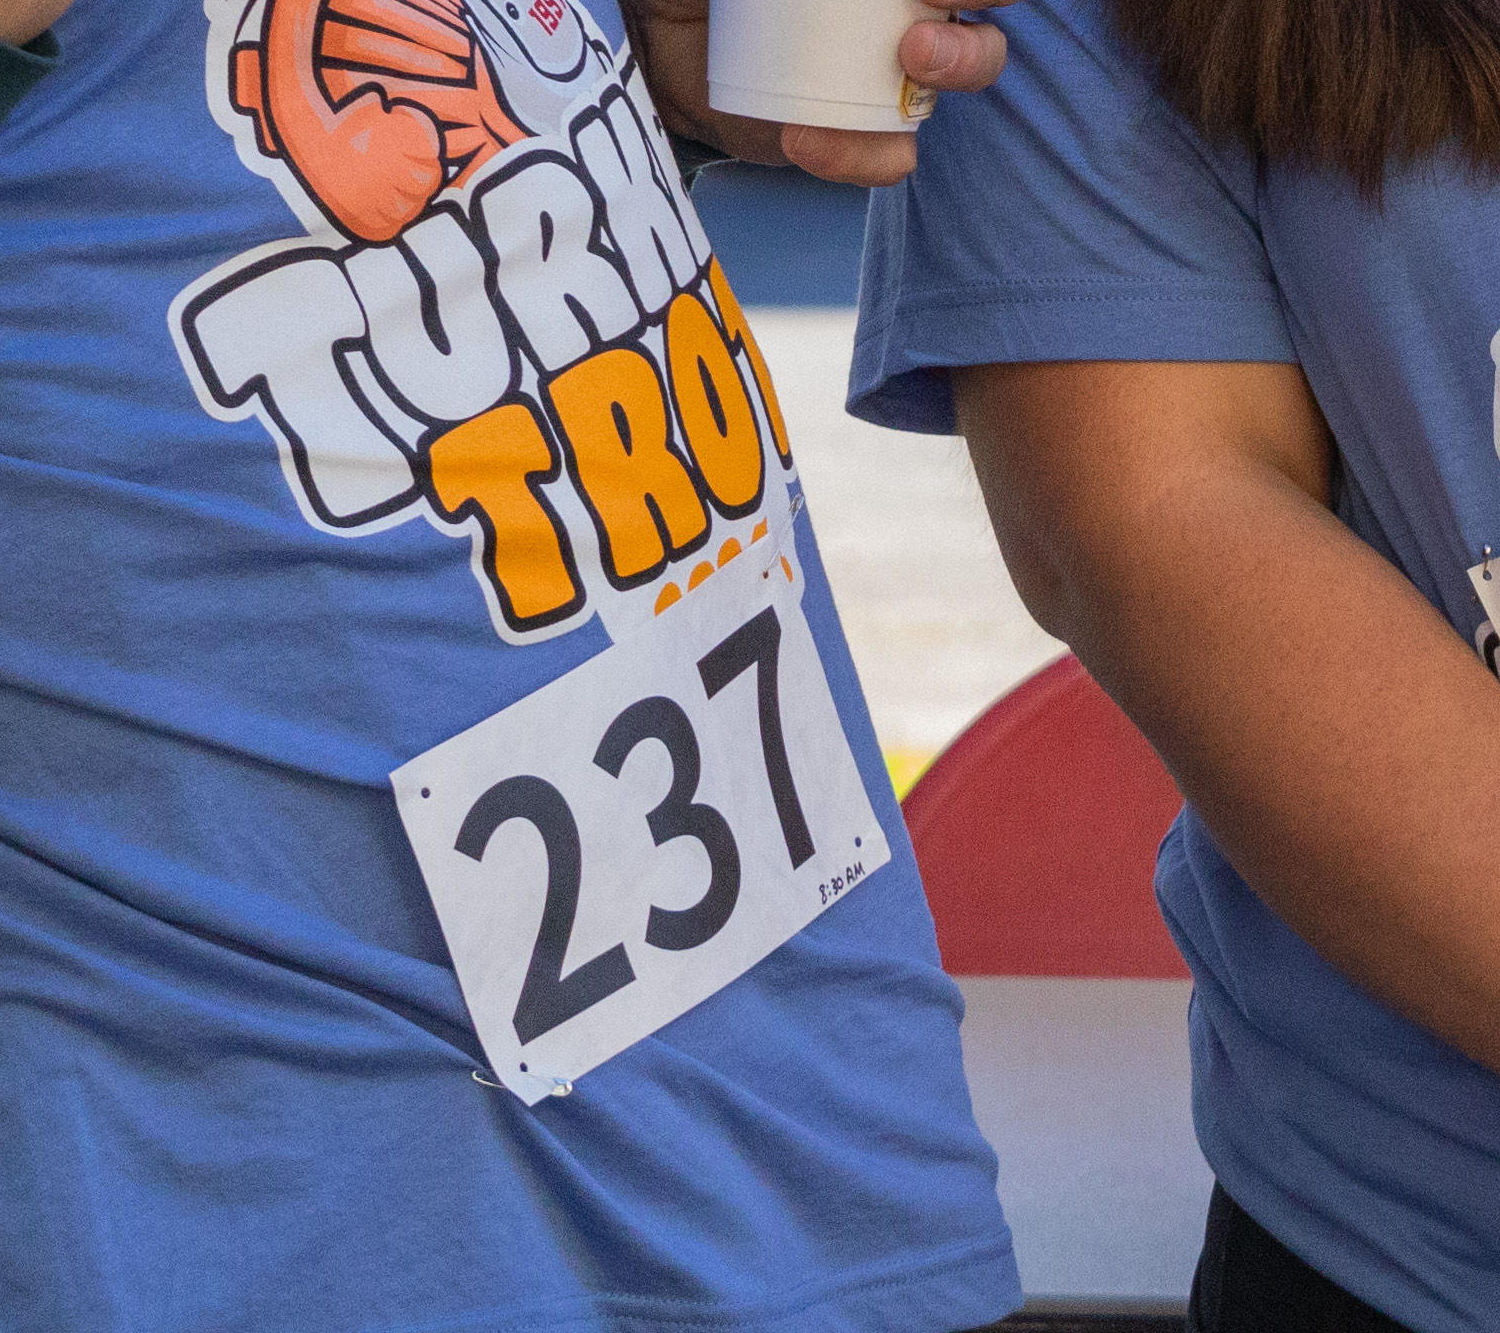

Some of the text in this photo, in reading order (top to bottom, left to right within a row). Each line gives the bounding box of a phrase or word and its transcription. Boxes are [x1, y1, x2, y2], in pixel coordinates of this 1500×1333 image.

[180, 48, 712, 530] TURK
[452, 603, 817, 1048] 237
[818, 861, 866, 905] 8:30 AM
